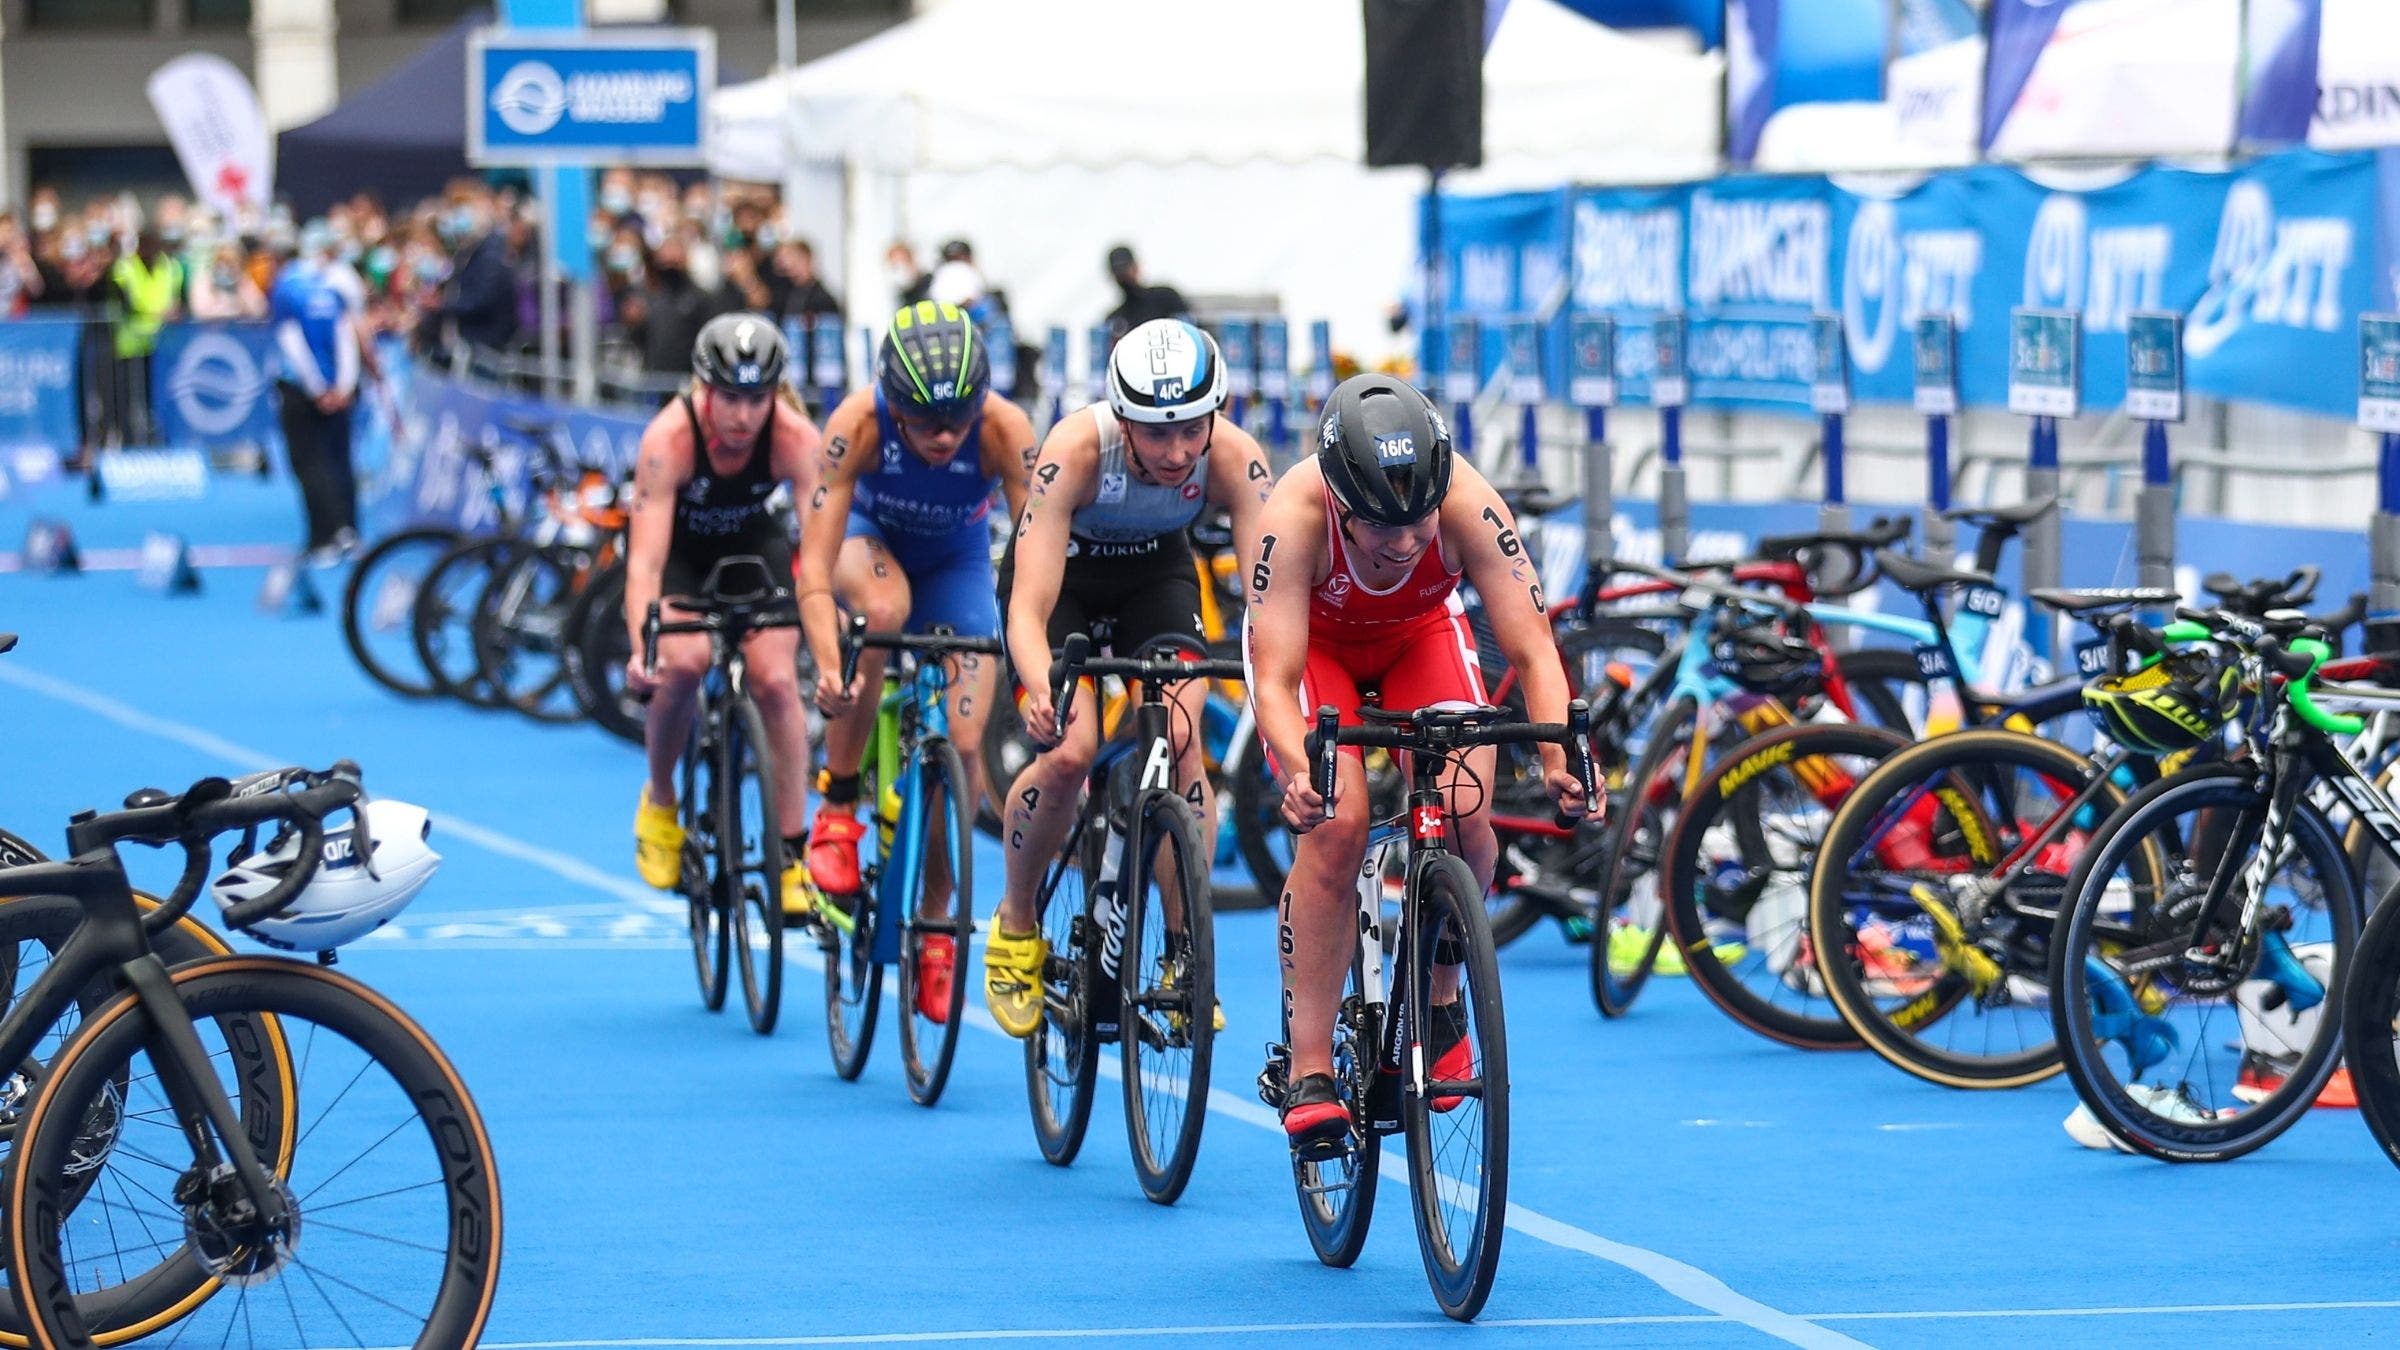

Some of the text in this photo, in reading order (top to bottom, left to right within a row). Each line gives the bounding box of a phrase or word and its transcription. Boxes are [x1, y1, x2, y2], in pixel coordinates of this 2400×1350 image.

[1159, 382, 1183, 401] 4/C
[827, 436, 848, 459] 5
[1379, 437, 1414, 458] 16/C
[1037, 462, 1060, 486] 4
[1248, 460, 1268, 482] 4
[1418, 577, 1452, 599] FUSION
[1529, 584, 1546, 615] C
[1581, 745, 1594, 793] ULTEGRA
[1021, 785, 1041, 812] 4
[1010, 829, 1023, 851] C
[2240, 799, 2283, 935] SCOTT
[1279, 890, 1296, 957] 16
